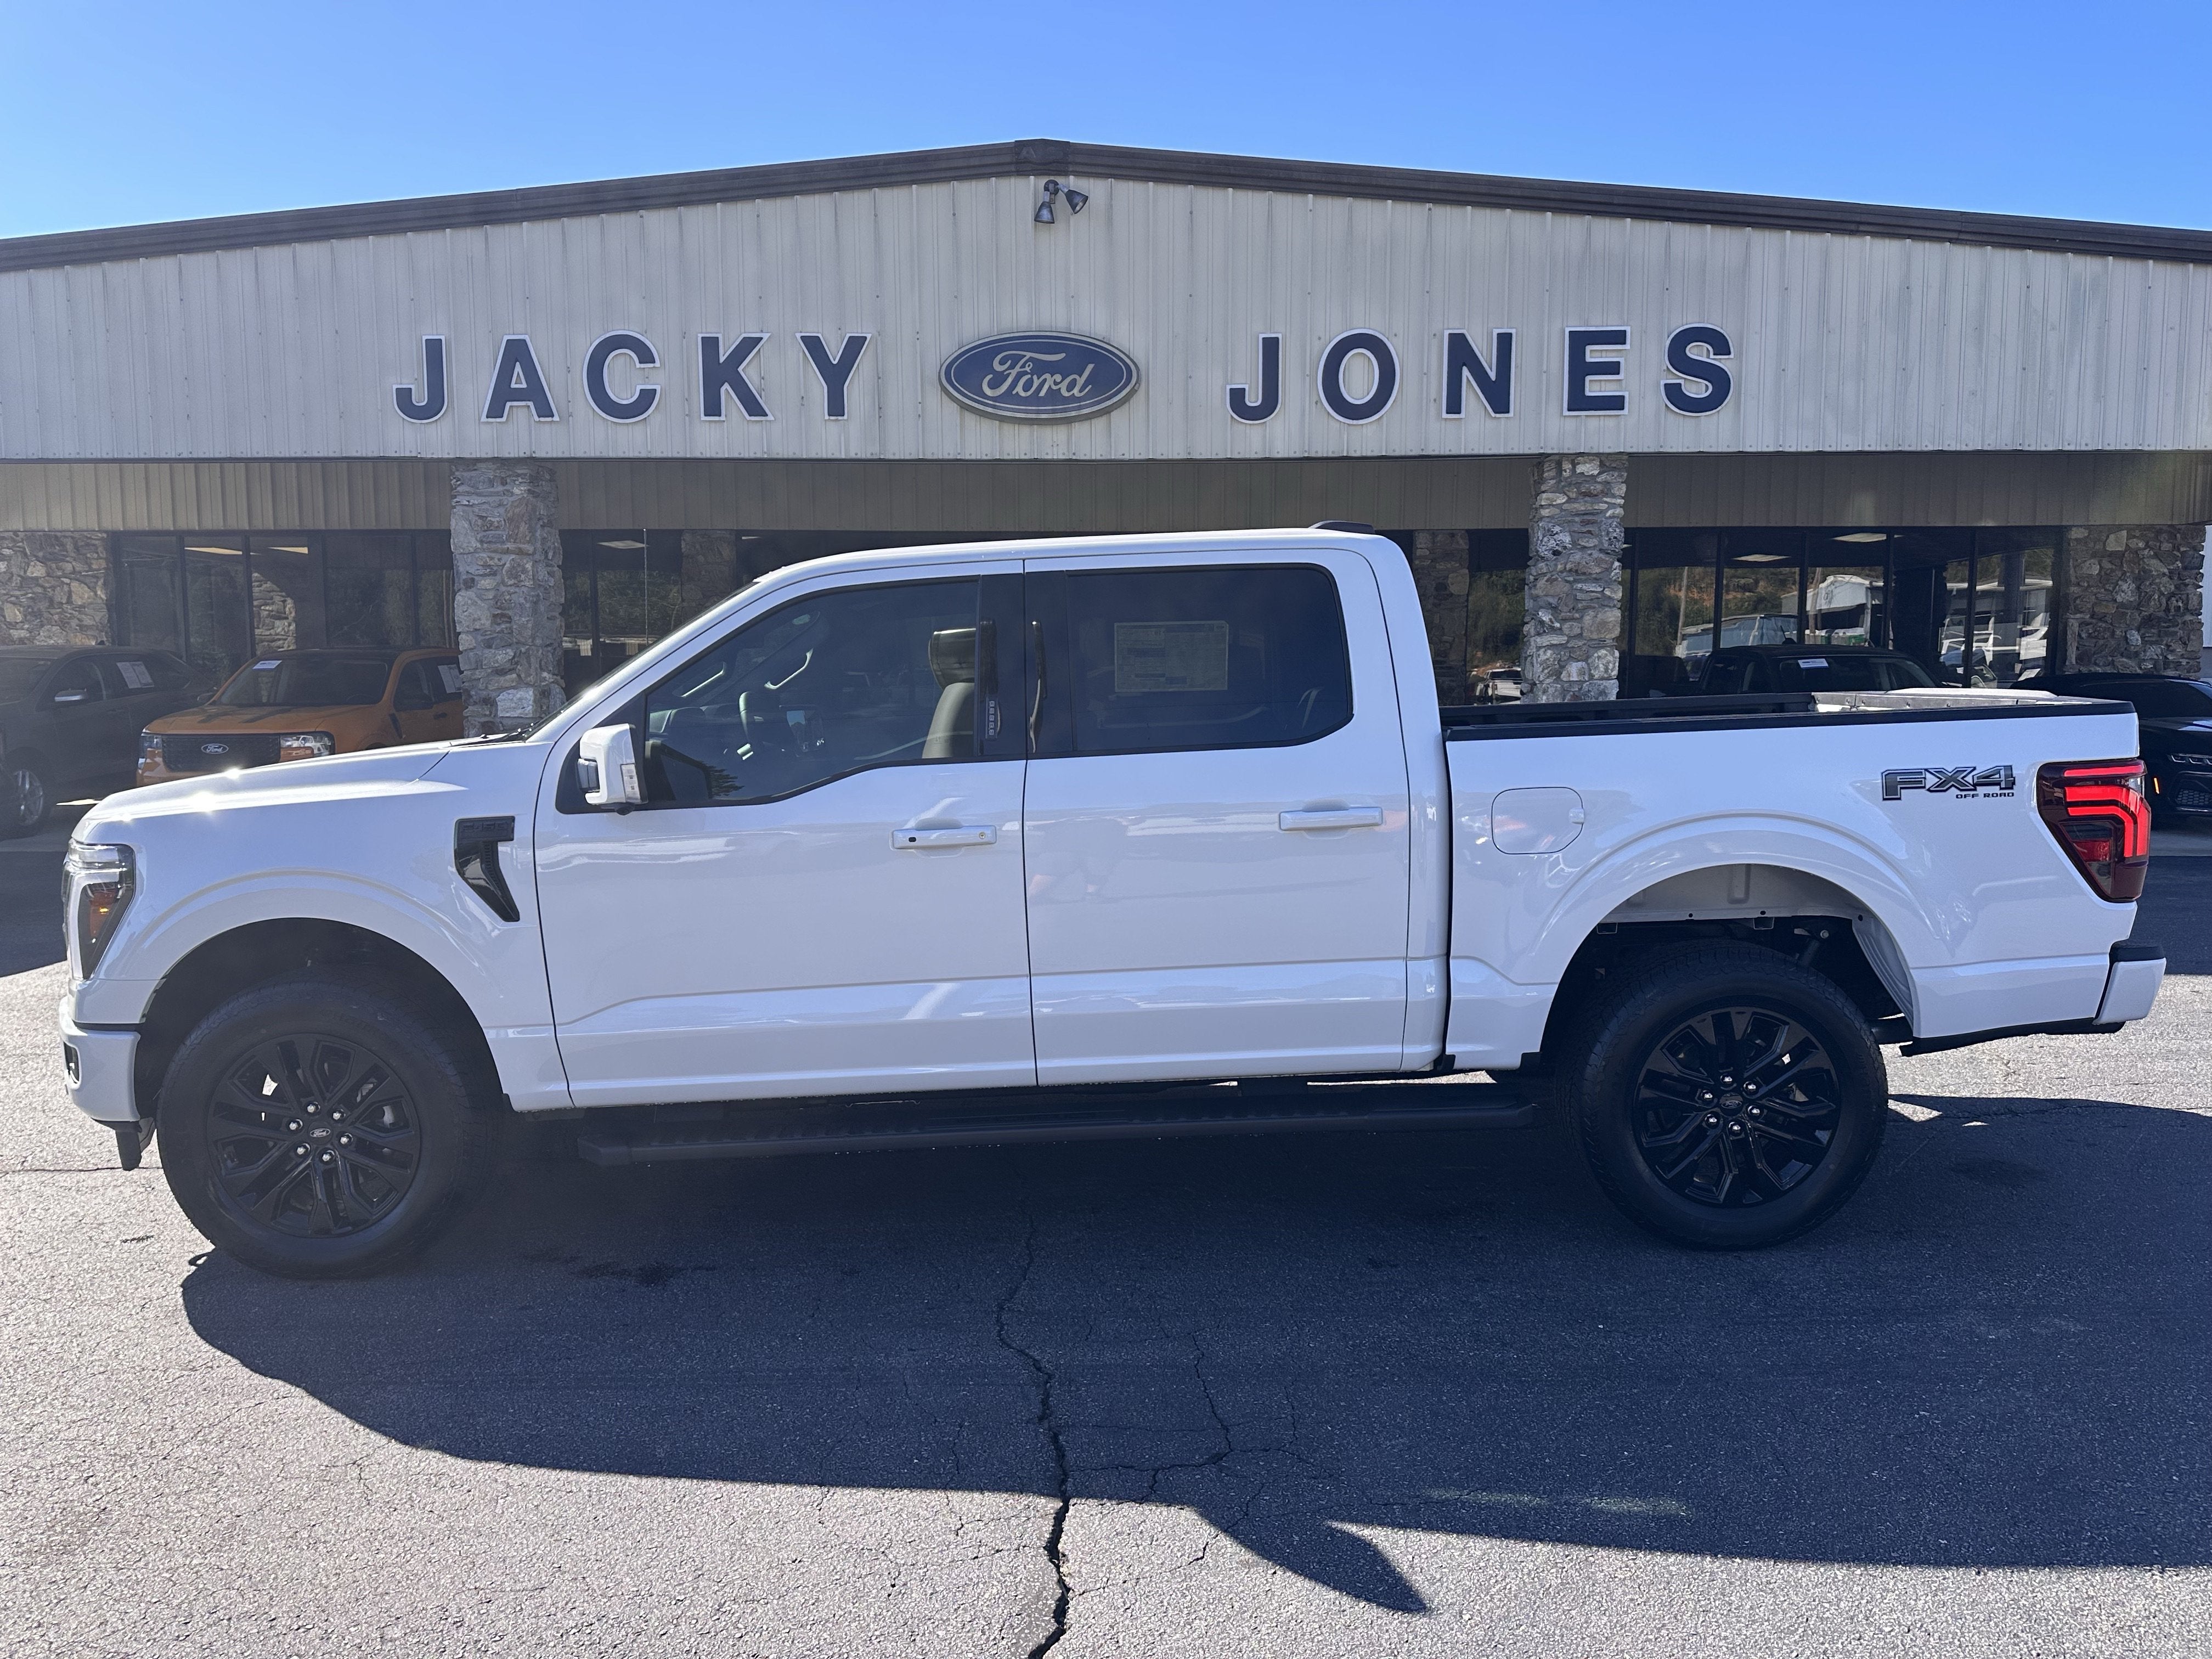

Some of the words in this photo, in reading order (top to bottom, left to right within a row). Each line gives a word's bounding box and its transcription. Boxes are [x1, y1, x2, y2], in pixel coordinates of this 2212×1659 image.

[392, 330, 872, 424] JACKY
[981, 350, 1096, 397] Ford
[1226, 323, 1734, 425] JONES
[1881, 765, 2016, 801] FX4
